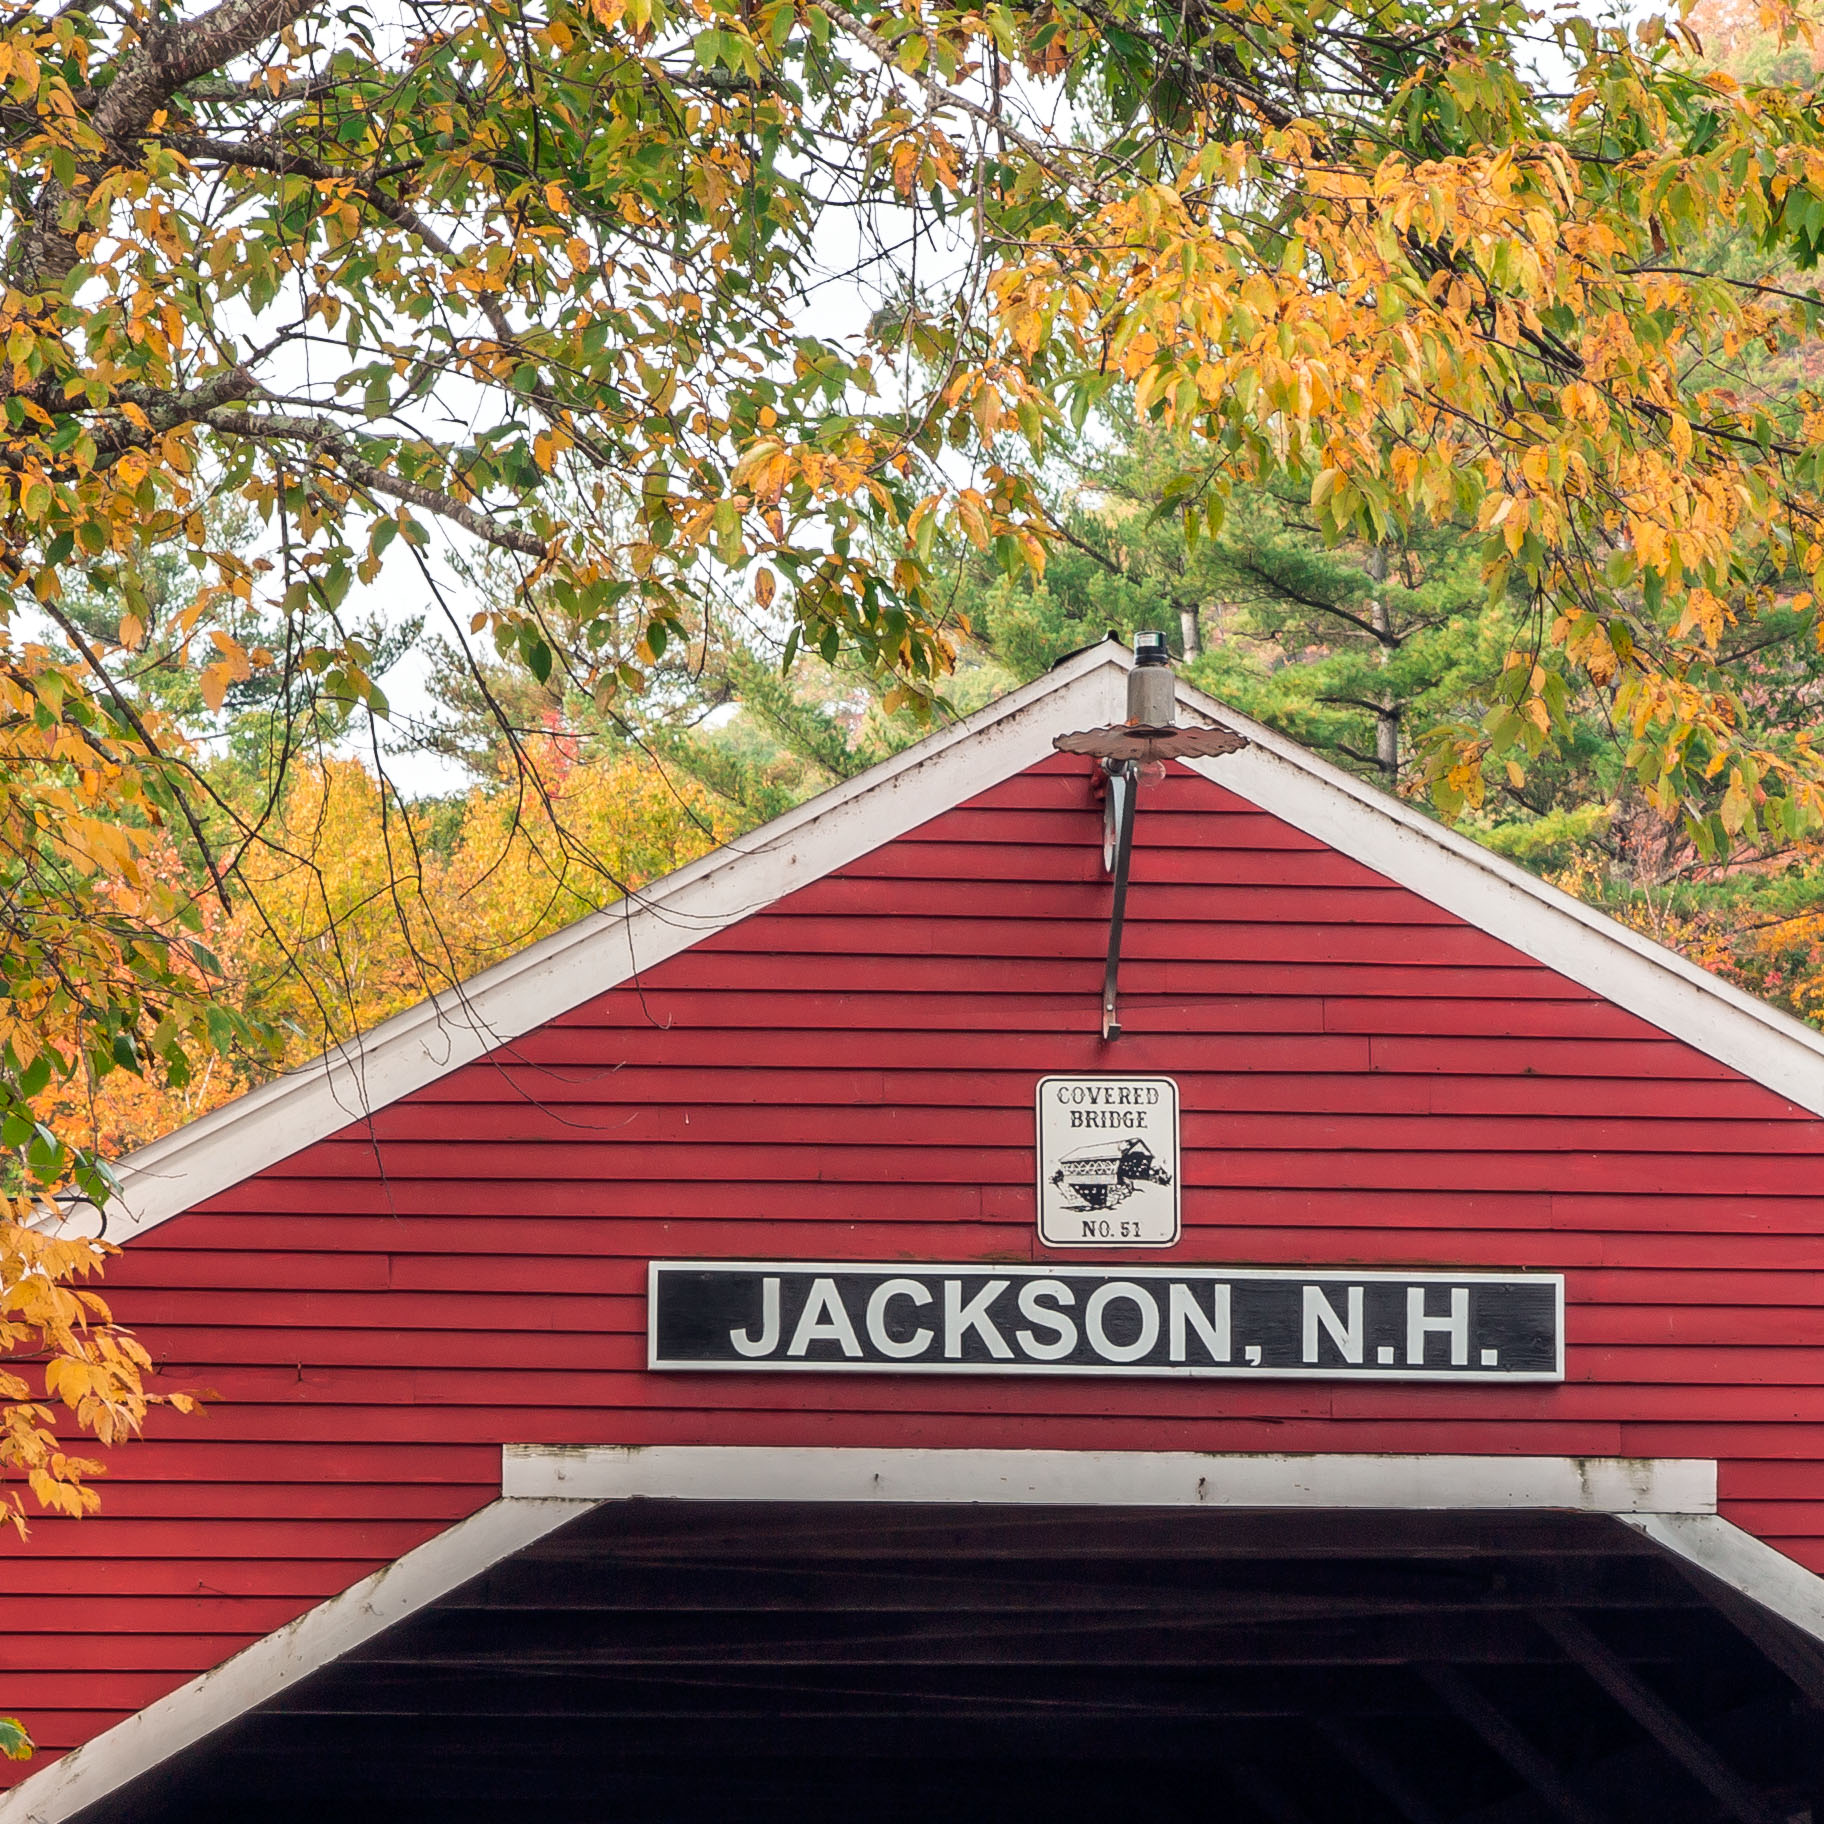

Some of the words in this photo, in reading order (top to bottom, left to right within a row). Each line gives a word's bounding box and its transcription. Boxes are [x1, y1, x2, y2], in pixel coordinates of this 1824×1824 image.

[1056, 1086, 1160, 1106] COVERED
[1070, 1110, 1148, 1129] BRIDGE
[1081, 1220, 1115, 1238] NO.
[1120, 1220, 1142, 1238] 51
[730, 1278, 1262, 1367] JACKSON,
[1302, 1285, 1500, 1367] N.H.
